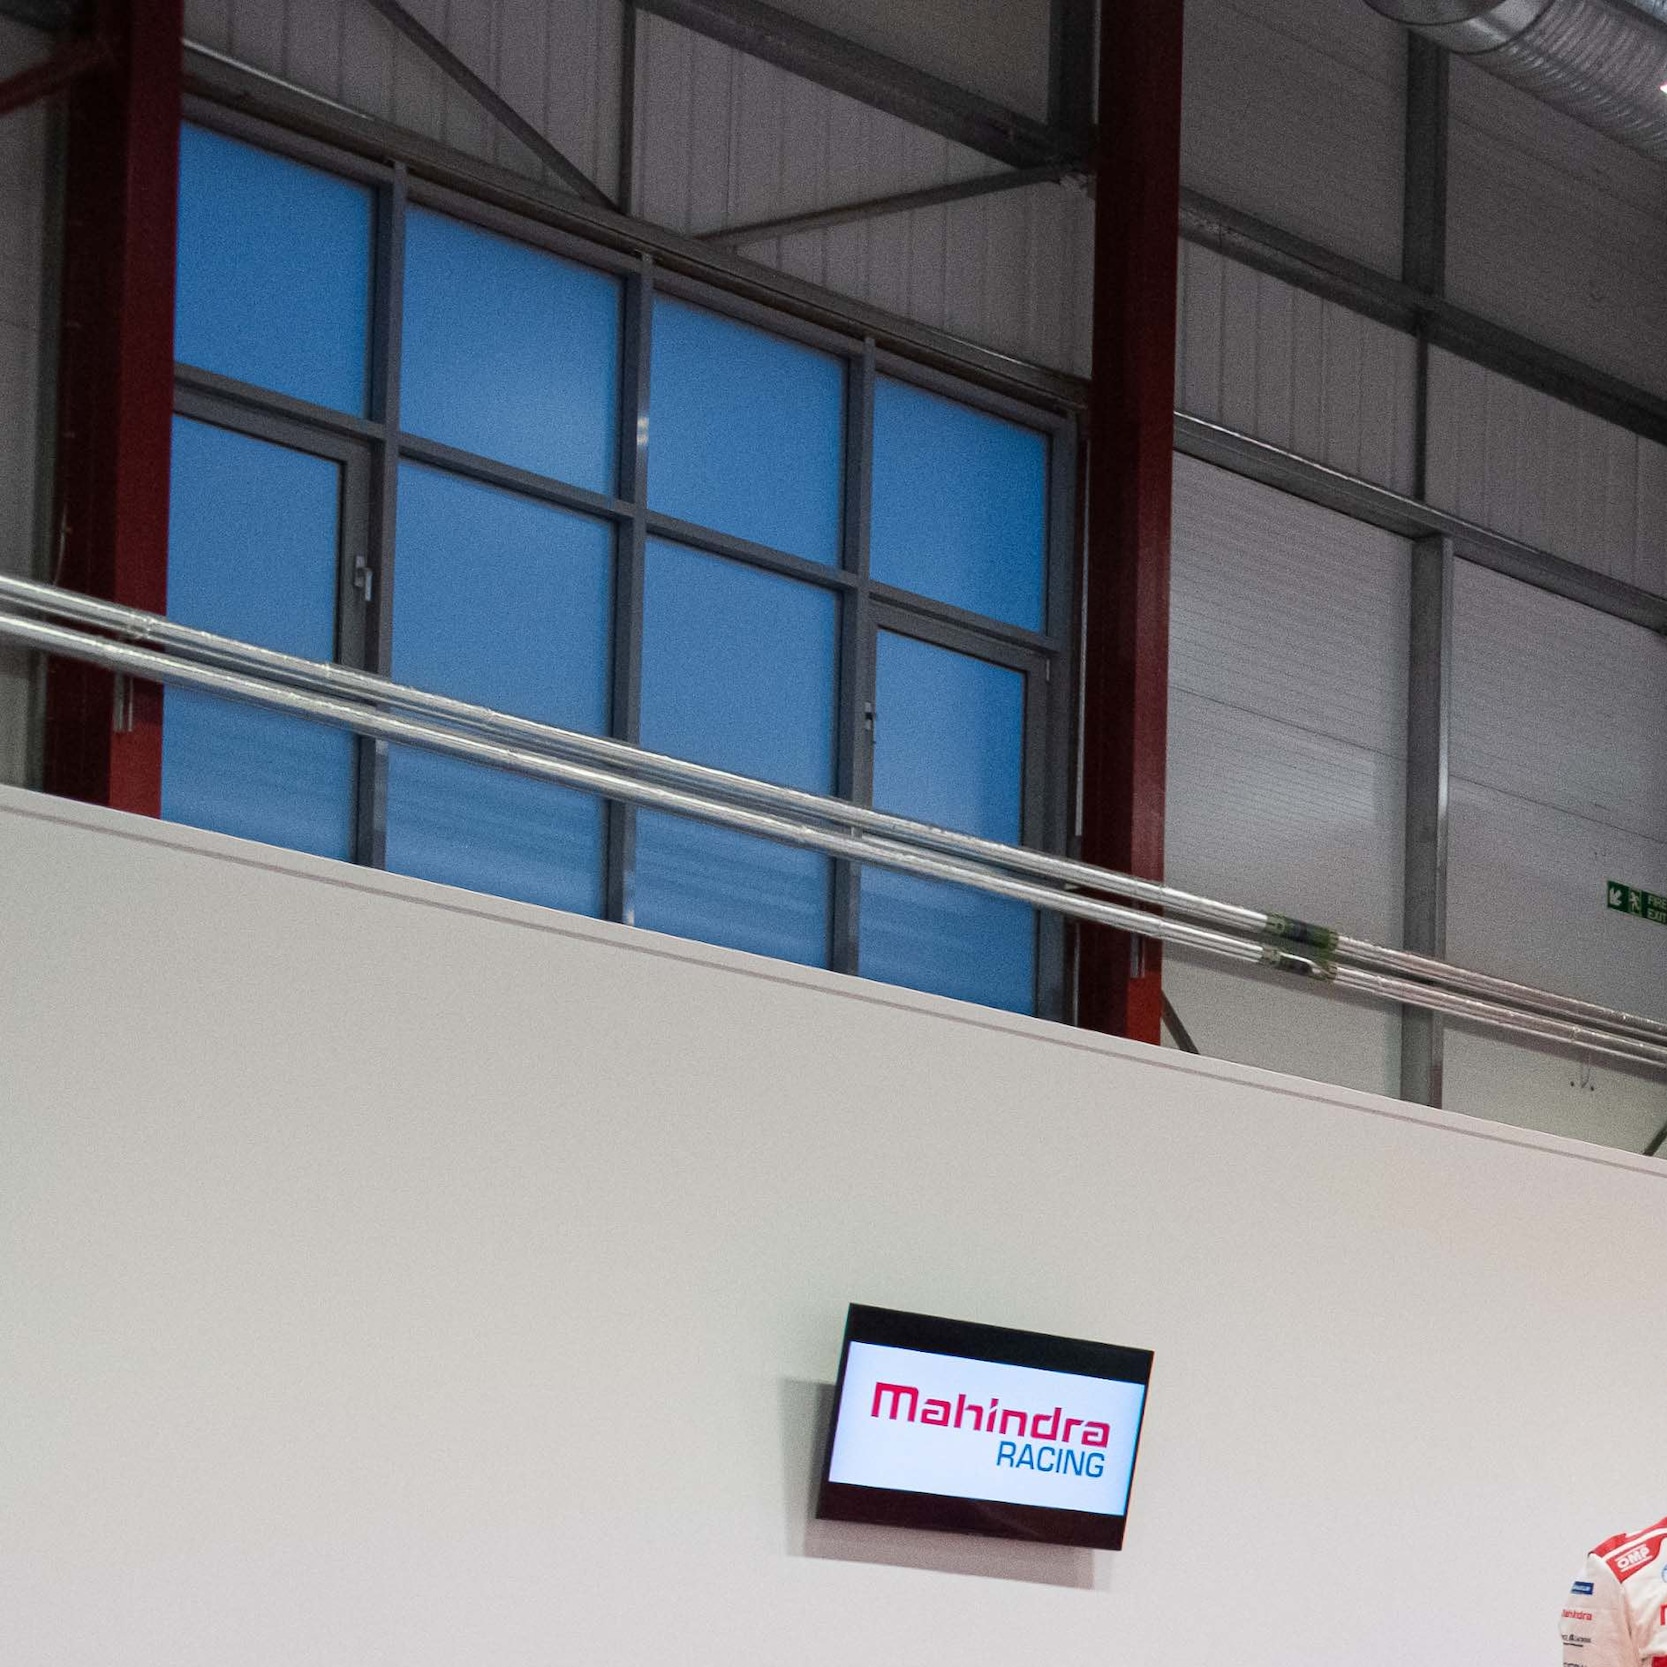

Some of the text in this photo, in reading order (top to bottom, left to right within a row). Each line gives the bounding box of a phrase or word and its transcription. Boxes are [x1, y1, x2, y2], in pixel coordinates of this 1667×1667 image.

[1648, 895, 1667, 911] FIRE
[1647, 908, 1667, 923] EXIT
[871, 1382, 1110, 1448] Mahindra
[996, 1441, 1105, 1478] RACING
[1617, 1548, 1650, 1570] OMP
